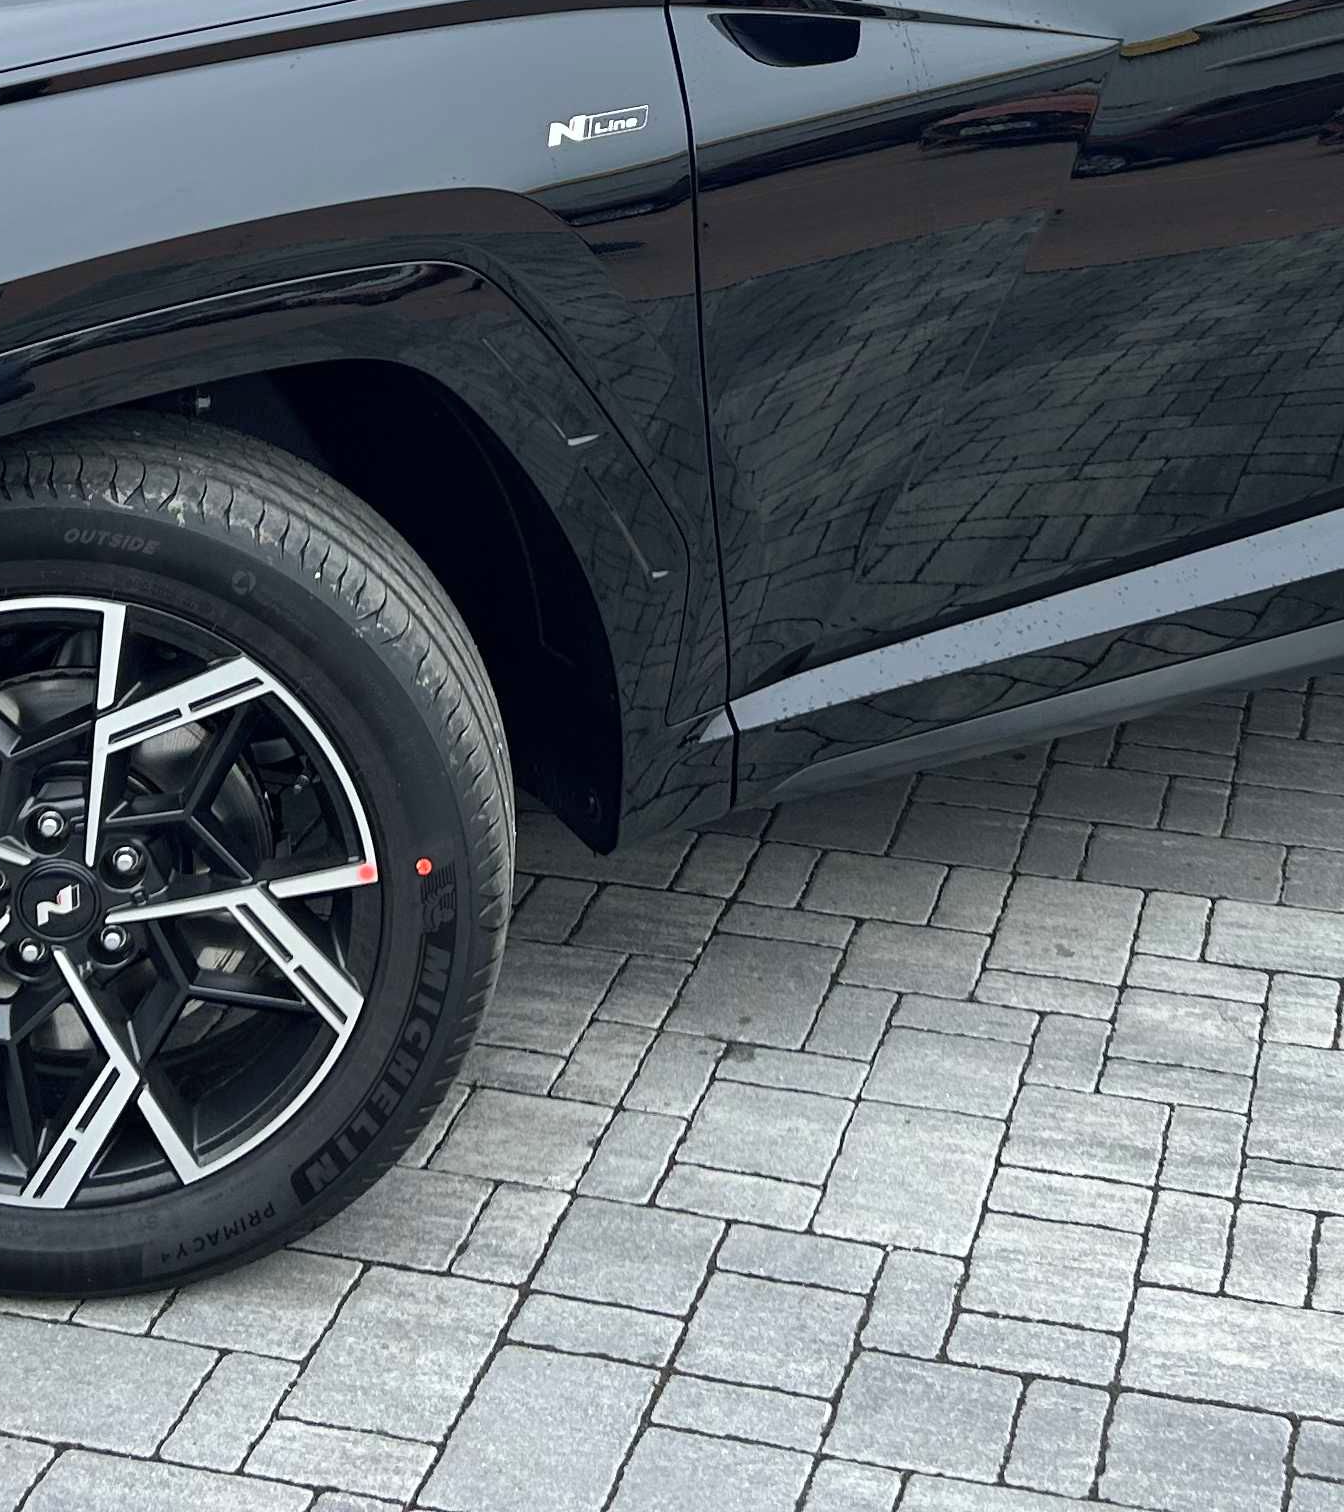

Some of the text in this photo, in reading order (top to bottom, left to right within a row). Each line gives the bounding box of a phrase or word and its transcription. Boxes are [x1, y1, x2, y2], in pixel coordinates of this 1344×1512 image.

[63, 527, 161, 557] OUTSIDE
[304, 945, 451, 1195] MICHELIN
[175, 1199, 278, 1261] PRIMACY
